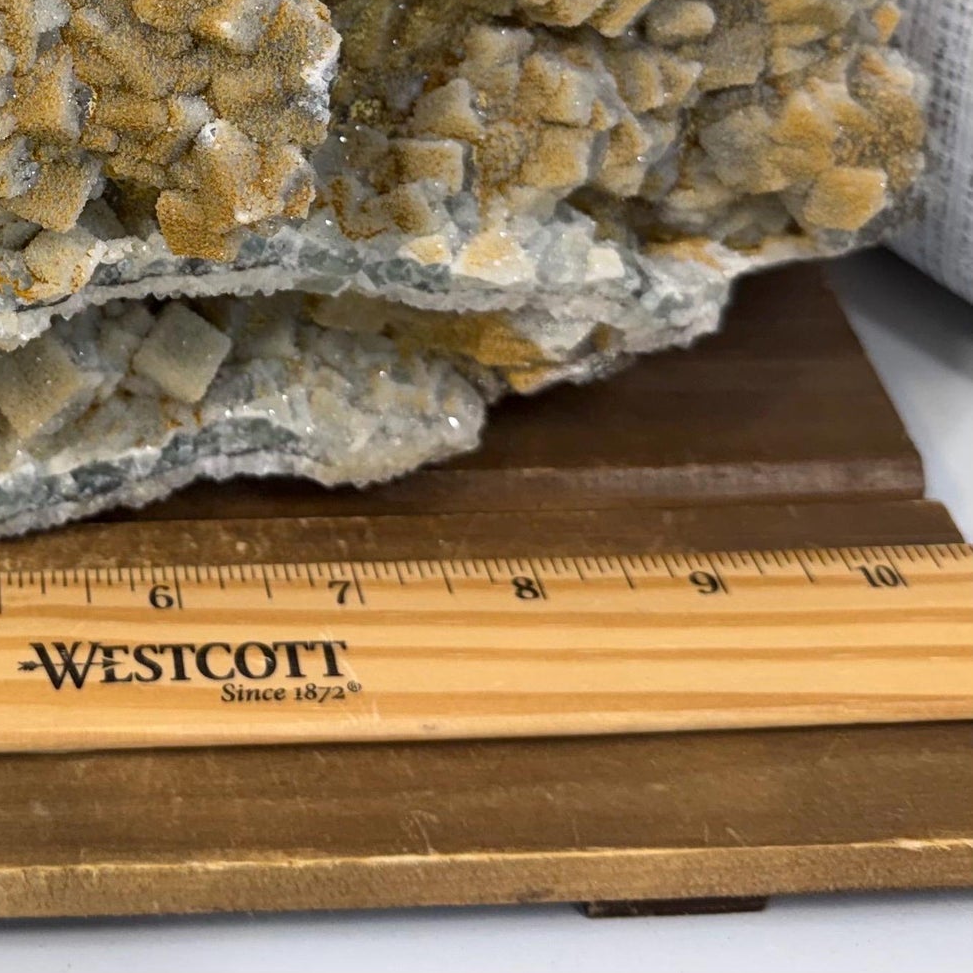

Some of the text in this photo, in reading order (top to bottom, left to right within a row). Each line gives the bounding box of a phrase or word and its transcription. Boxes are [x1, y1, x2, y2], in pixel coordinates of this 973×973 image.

[149, 584, 174, 610] 6
[329, 580, 352, 604] 7
[513, 576, 539, 600] 8
[689, 571, 718, 595] 9
[858, 564, 900, 589] 10
[27, 640, 347, 690] WESTCOTT
[221, 682, 286, 704] Since
